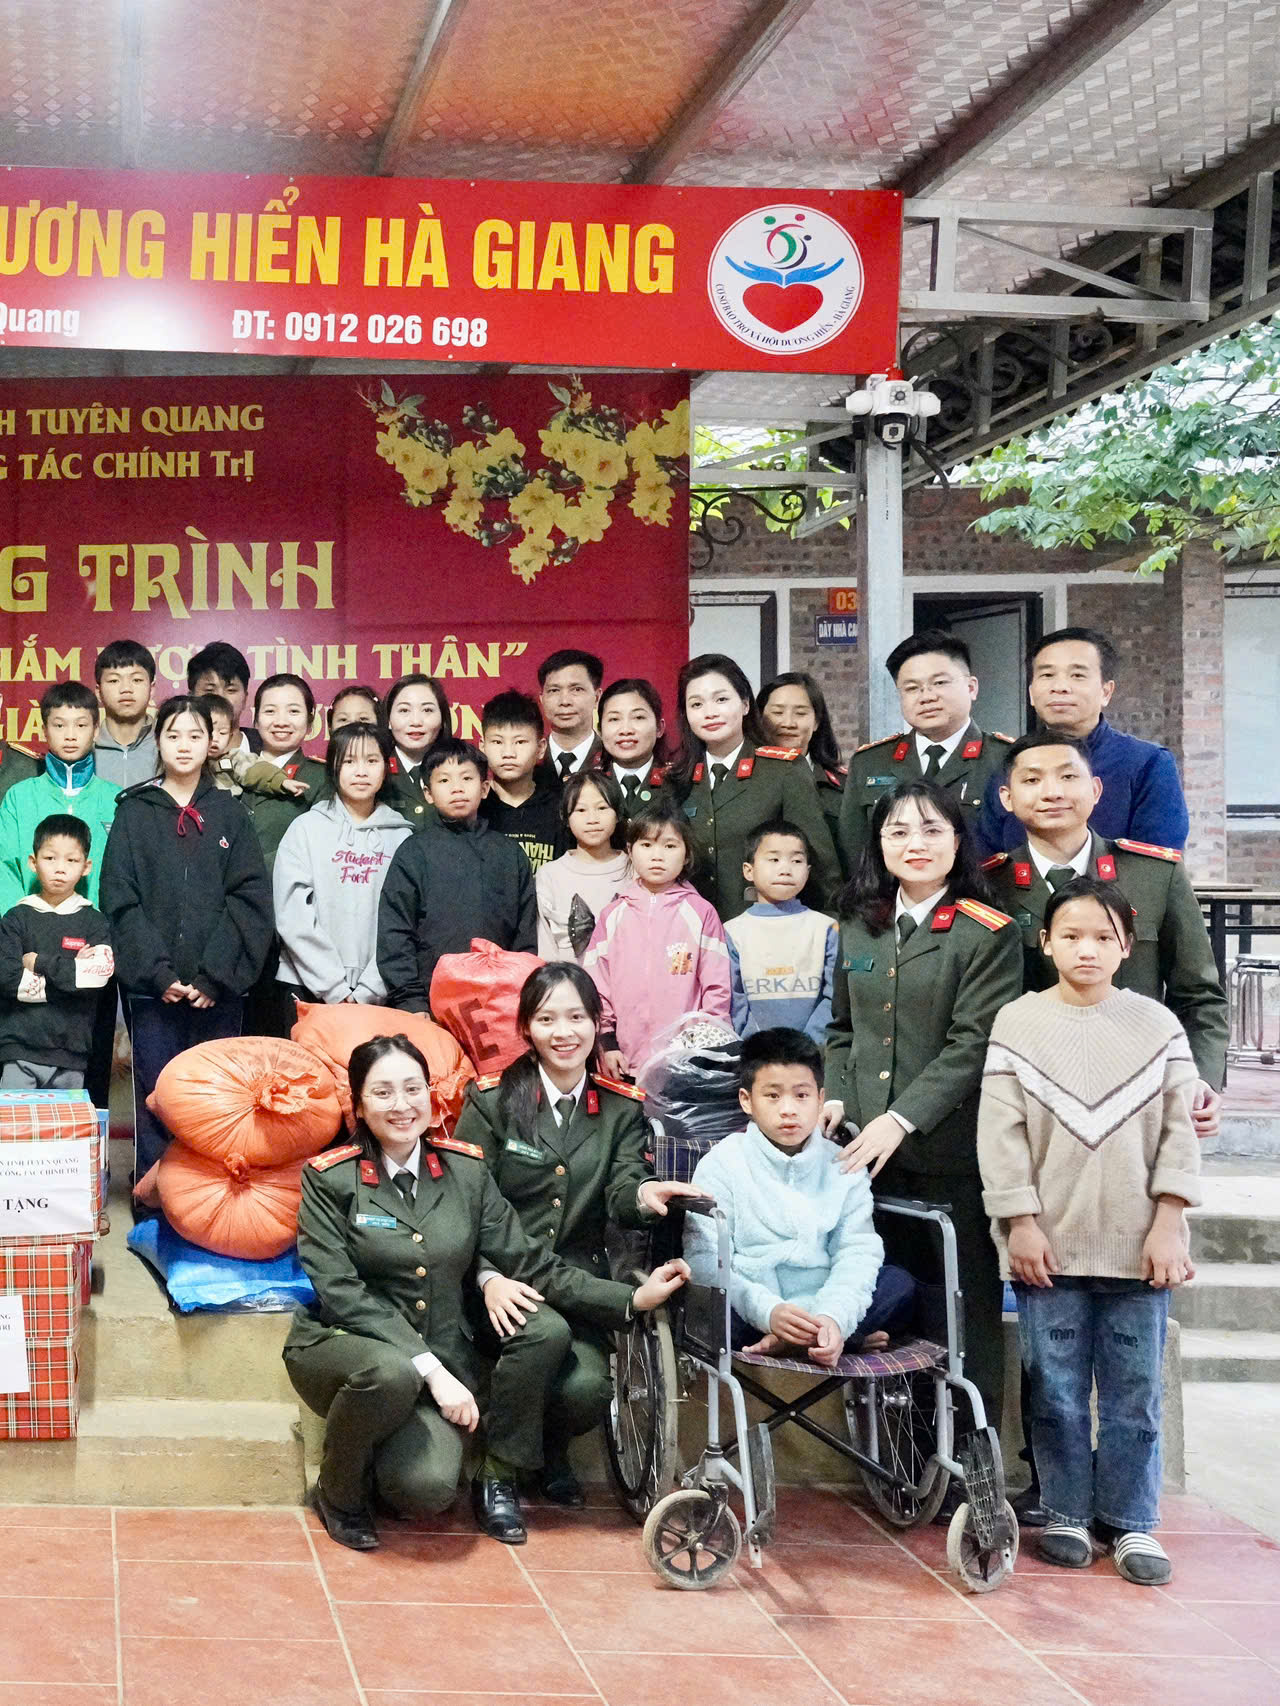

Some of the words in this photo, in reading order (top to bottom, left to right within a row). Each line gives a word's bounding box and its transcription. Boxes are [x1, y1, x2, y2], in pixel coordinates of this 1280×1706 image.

[190, 185, 341, 285] HIỂN
[364, 204, 449, 288] HÀ
[473, 220, 674, 293] GIANG
[232, 309, 275, 340] ĐT:
[286, 312, 358, 342] 0912
[368, 315, 422, 344] 026
[433, 317, 487, 347] 698
[26, 402, 130, 435] TUYÊN
[142, 405, 264, 436] QUANG
[19, 448, 82, 479] TÁC
[93, 446, 200, 478] CHÍNH
[79, 526, 334, 618] TRÌNH
[836, 591, 857, 610] 03
[247, 637, 358, 680] TÌNH
[3, 1197, 48, 1213] TẶNG
